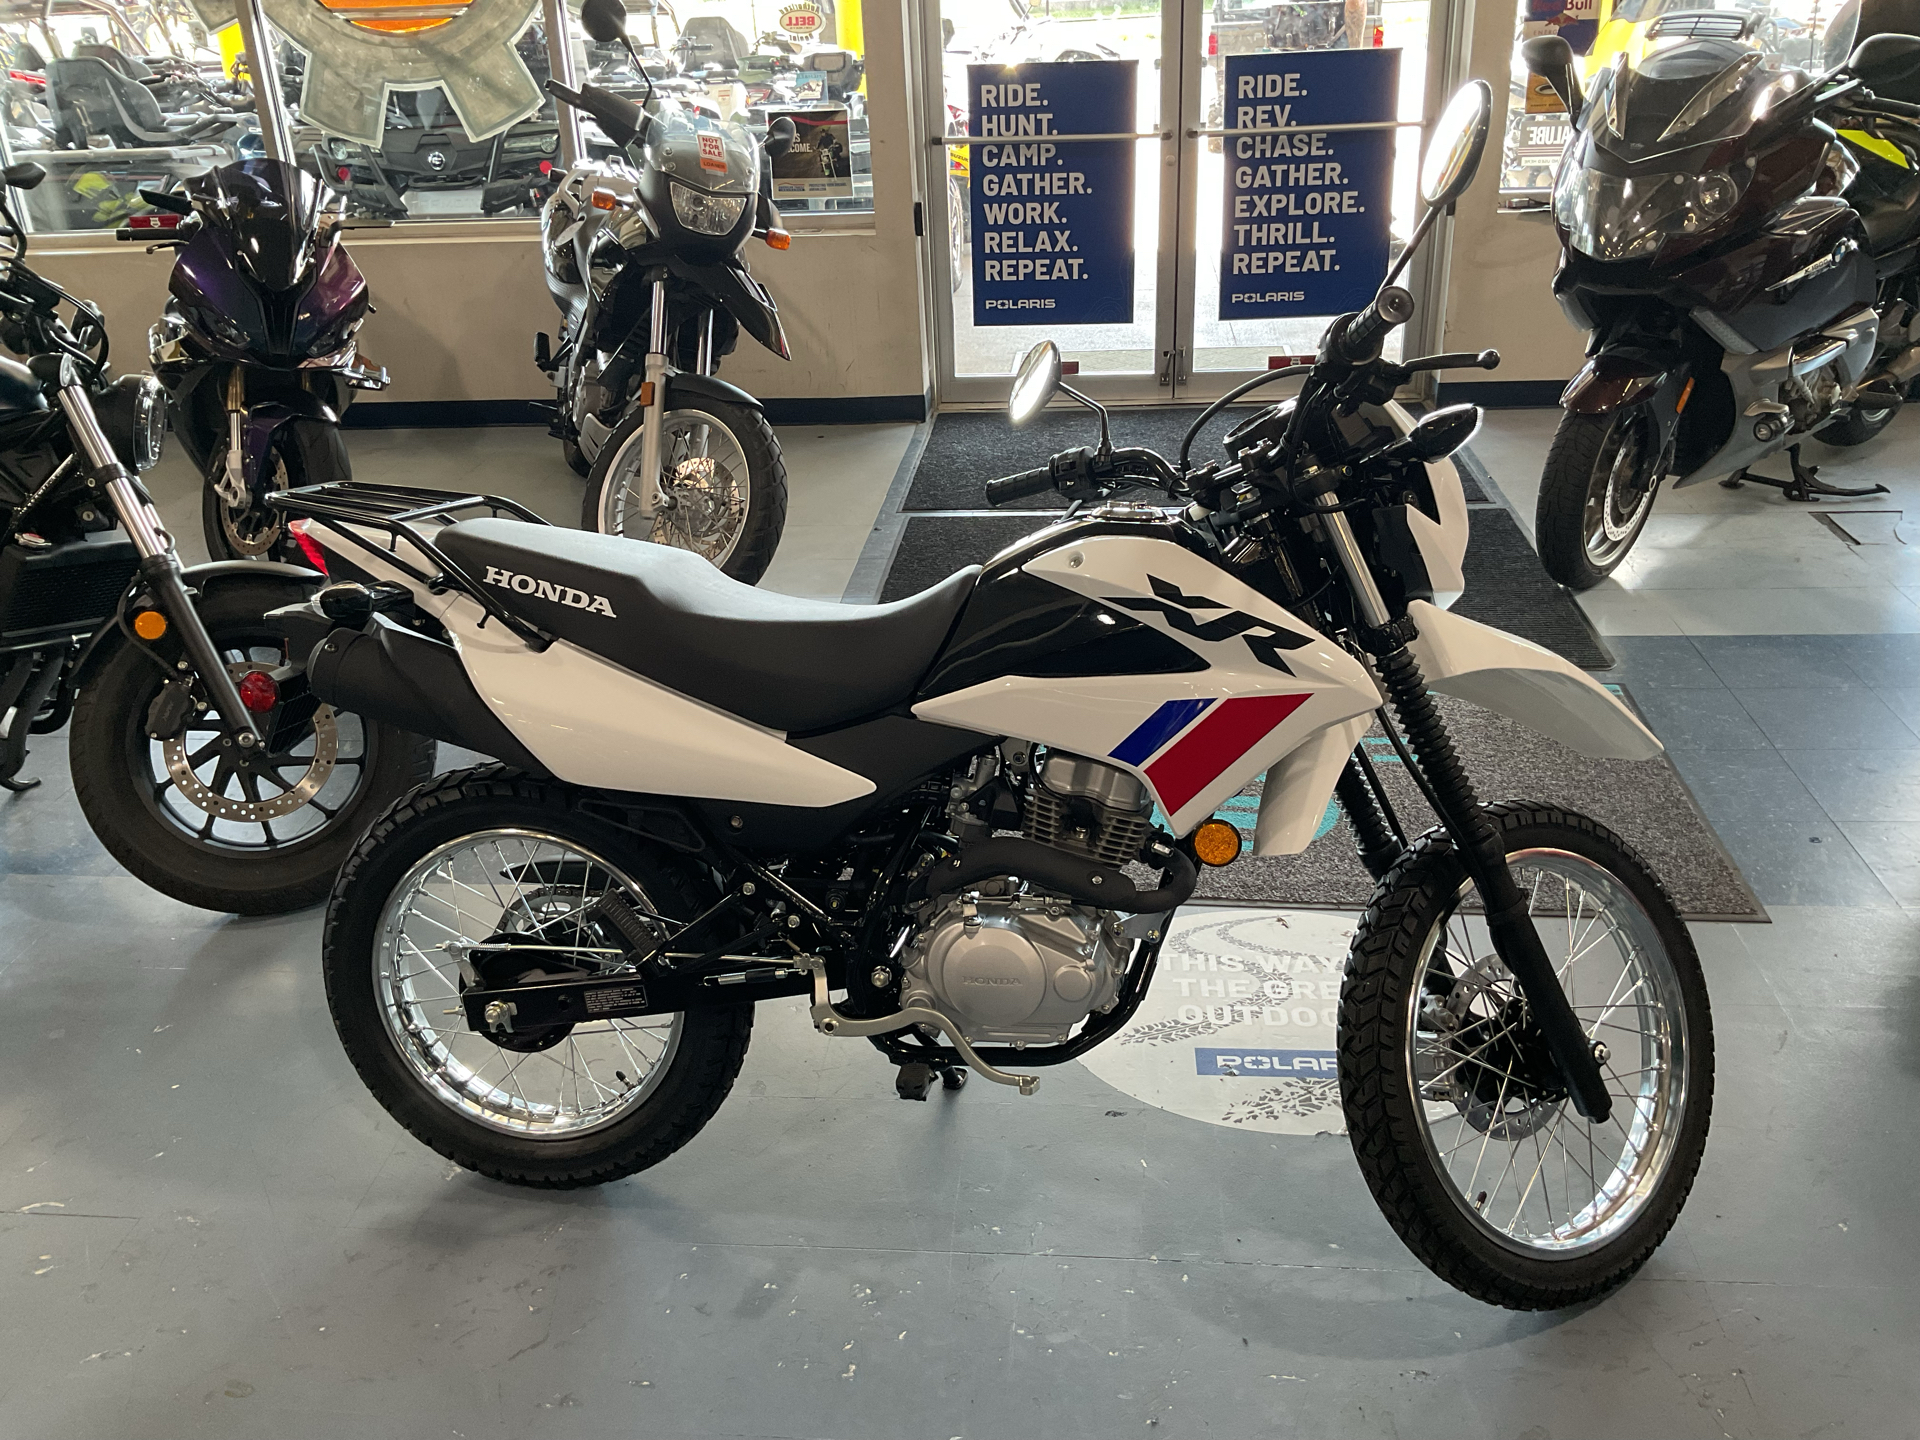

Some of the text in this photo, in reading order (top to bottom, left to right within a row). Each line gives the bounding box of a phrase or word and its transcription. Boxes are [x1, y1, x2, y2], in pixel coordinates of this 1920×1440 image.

[981, 83, 1048, 107] RIDE.
[1238, 73, 1307, 99] RIDE.
[981, 113, 1058, 137] HUNT.
[1237, 104, 1297, 129] REV.
[702, 149, 723, 157] SALE
[982, 144, 1063, 168] CAMP.
[1236, 133, 1334, 159] CHASE.
[983, 172, 1092, 197] GATHER.
[1235, 162, 1348, 188] GATHER.
[983, 202, 1067, 225] WORK.
[1234, 191, 1365, 218] EXPLORE.
[984, 230, 1078, 253] RELAX.
[1233, 221, 1335, 247] THRILL.
[985, 258, 1088, 282] REPEAT.
[1233, 249, 1340, 275] REPEAT.
[985, 299, 1056, 309] POLARIS
[1231, 291, 1305, 303] POLARIS
[483, 565, 617, 618] HONDA
[1159, 953, 1343, 974] THIS WAY
[962, 976, 1024, 987] HONDA
[1172, 978, 1339, 1000] THE GRE
[1216, 1055, 1337, 1071] POLAR
